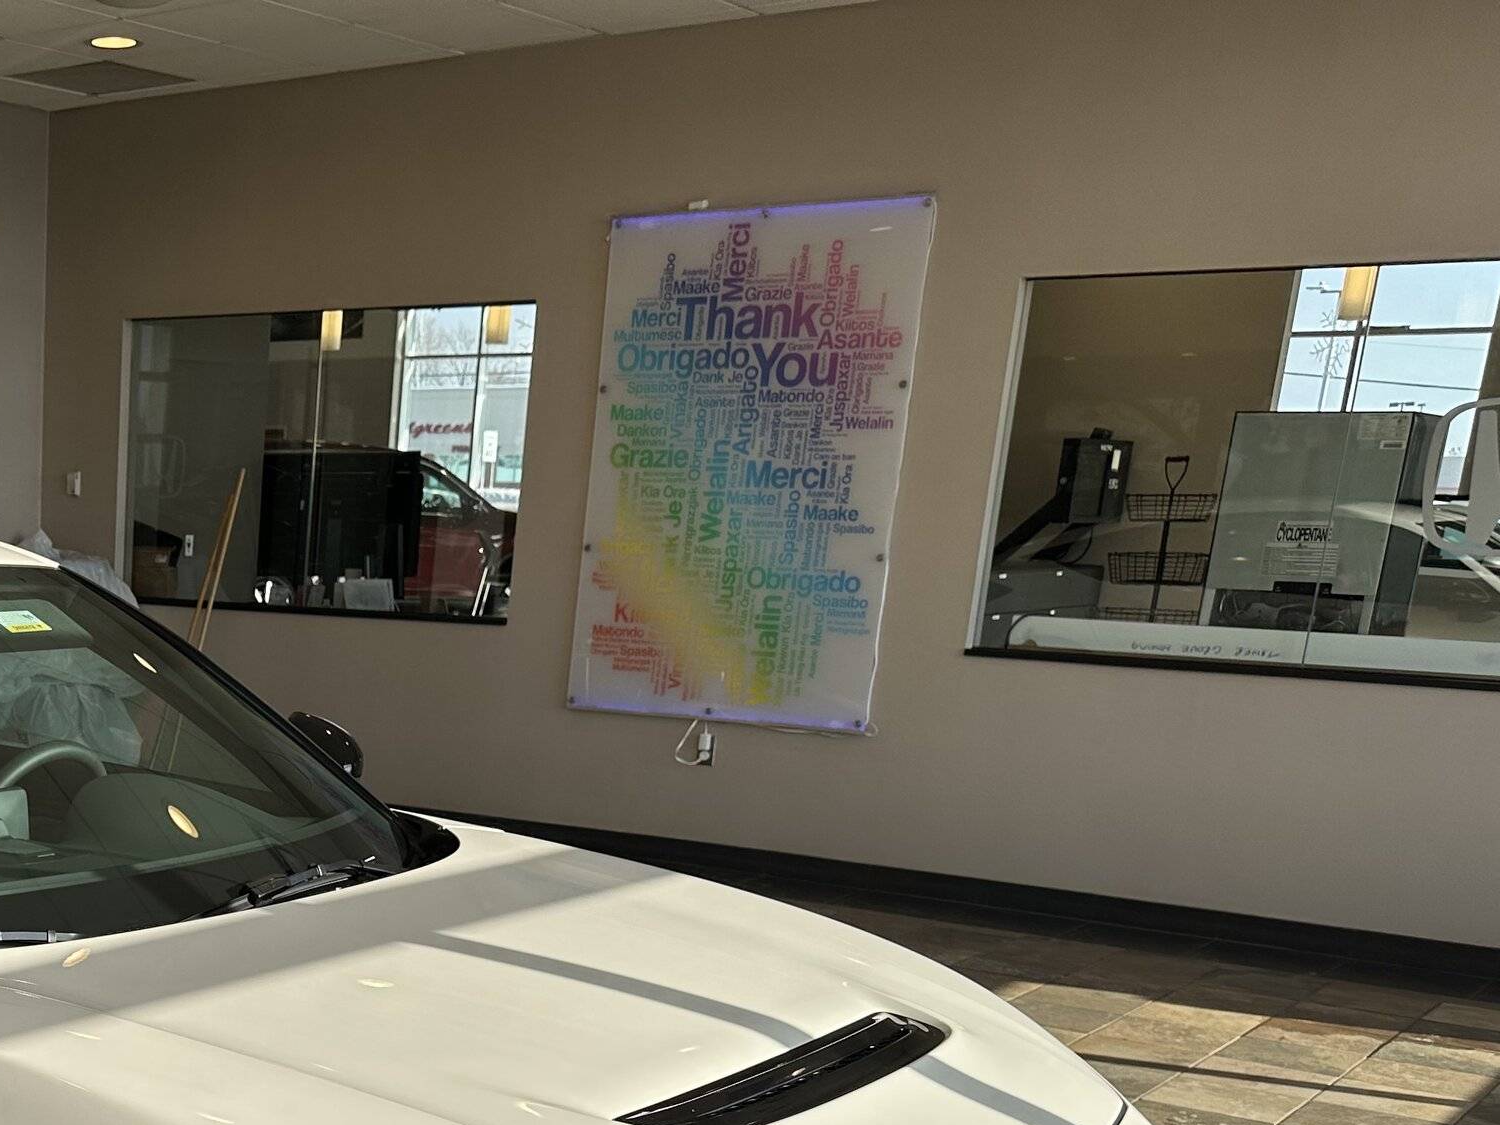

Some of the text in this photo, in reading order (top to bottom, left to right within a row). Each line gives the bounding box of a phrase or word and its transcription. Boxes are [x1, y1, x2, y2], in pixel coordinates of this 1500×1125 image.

[721, 222, 751, 302] Merci
[660, 253, 676, 311] Spasibo
[673, 280, 721, 295] Maake
[745, 286, 792, 301] Grazie
[820, 239, 844, 327] Obrigado
[842, 264, 860, 317] Welalin
[631, 306, 681, 328] Merci
[676, 291, 822, 341] Thank
[817, 328, 903, 351] Asante
[618, 341, 750, 380] Obrigado
[751, 342, 840, 388] You
[627, 381, 676, 396] Spasibo
[693, 371, 743, 384] Dank Je
[830, 351, 851, 432] Juspaxar
[732, 365, 759, 456] Arigato
[758, 388, 825, 404] Matondo
[610, 404, 664, 421] Maake
[844, 416, 894, 430] Welalin
[617, 424, 668, 438] Dankon
[610, 442, 690, 470] Grazie
[745, 460, 828, 490] Merci
[698, 440, 731, 543] Welalin
[726, 490, 777, 506] Maake
[778, 490, 801, 565] Spasibo
[803, 504, 860, 522] Maake
[720, 508, 743, 611] Juspaxar
[747, 566, 862, 597] Obrigado
[812, 593, 869, 609] Spasibo
